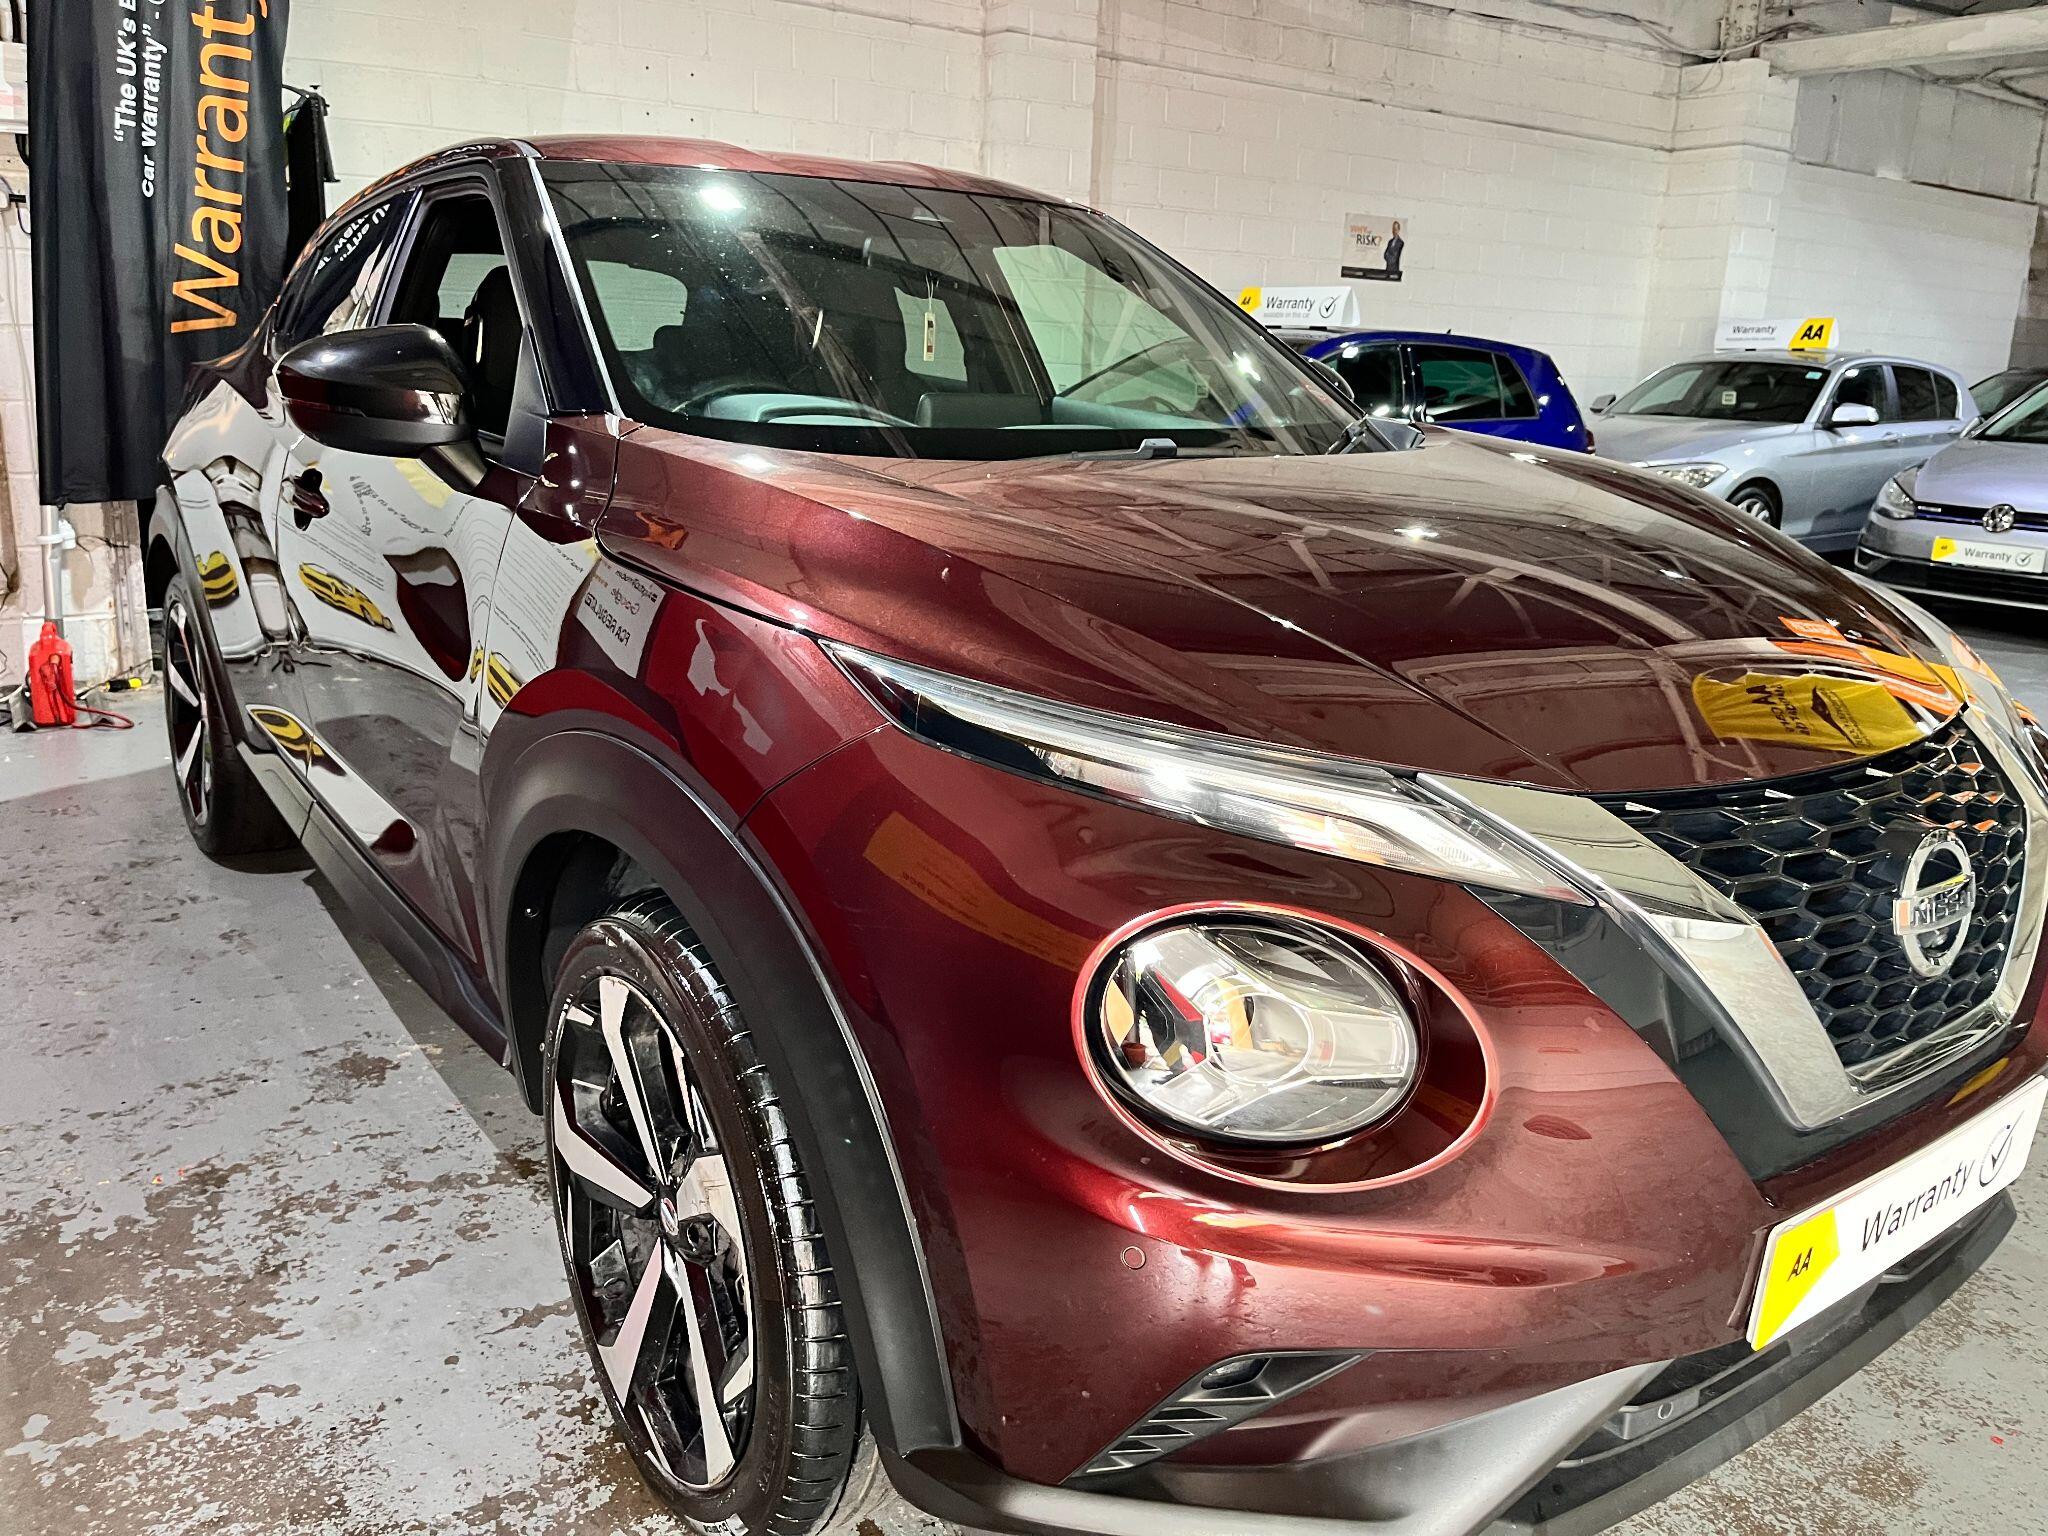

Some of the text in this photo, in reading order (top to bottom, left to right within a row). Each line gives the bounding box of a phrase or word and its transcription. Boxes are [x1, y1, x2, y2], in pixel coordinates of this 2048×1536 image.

[141, 154, 155, 198] car
[1266, 296, 1315, 312] Warranty
[1732, 325, 1777, 335] Warranty
[1800, 324, 1825, 340] AA
[1964, 547, 2012, 562] Warranty
[1861, 1159, 1975, 1252] Warranty
[1786, 1247, 1813, 1282] AA
